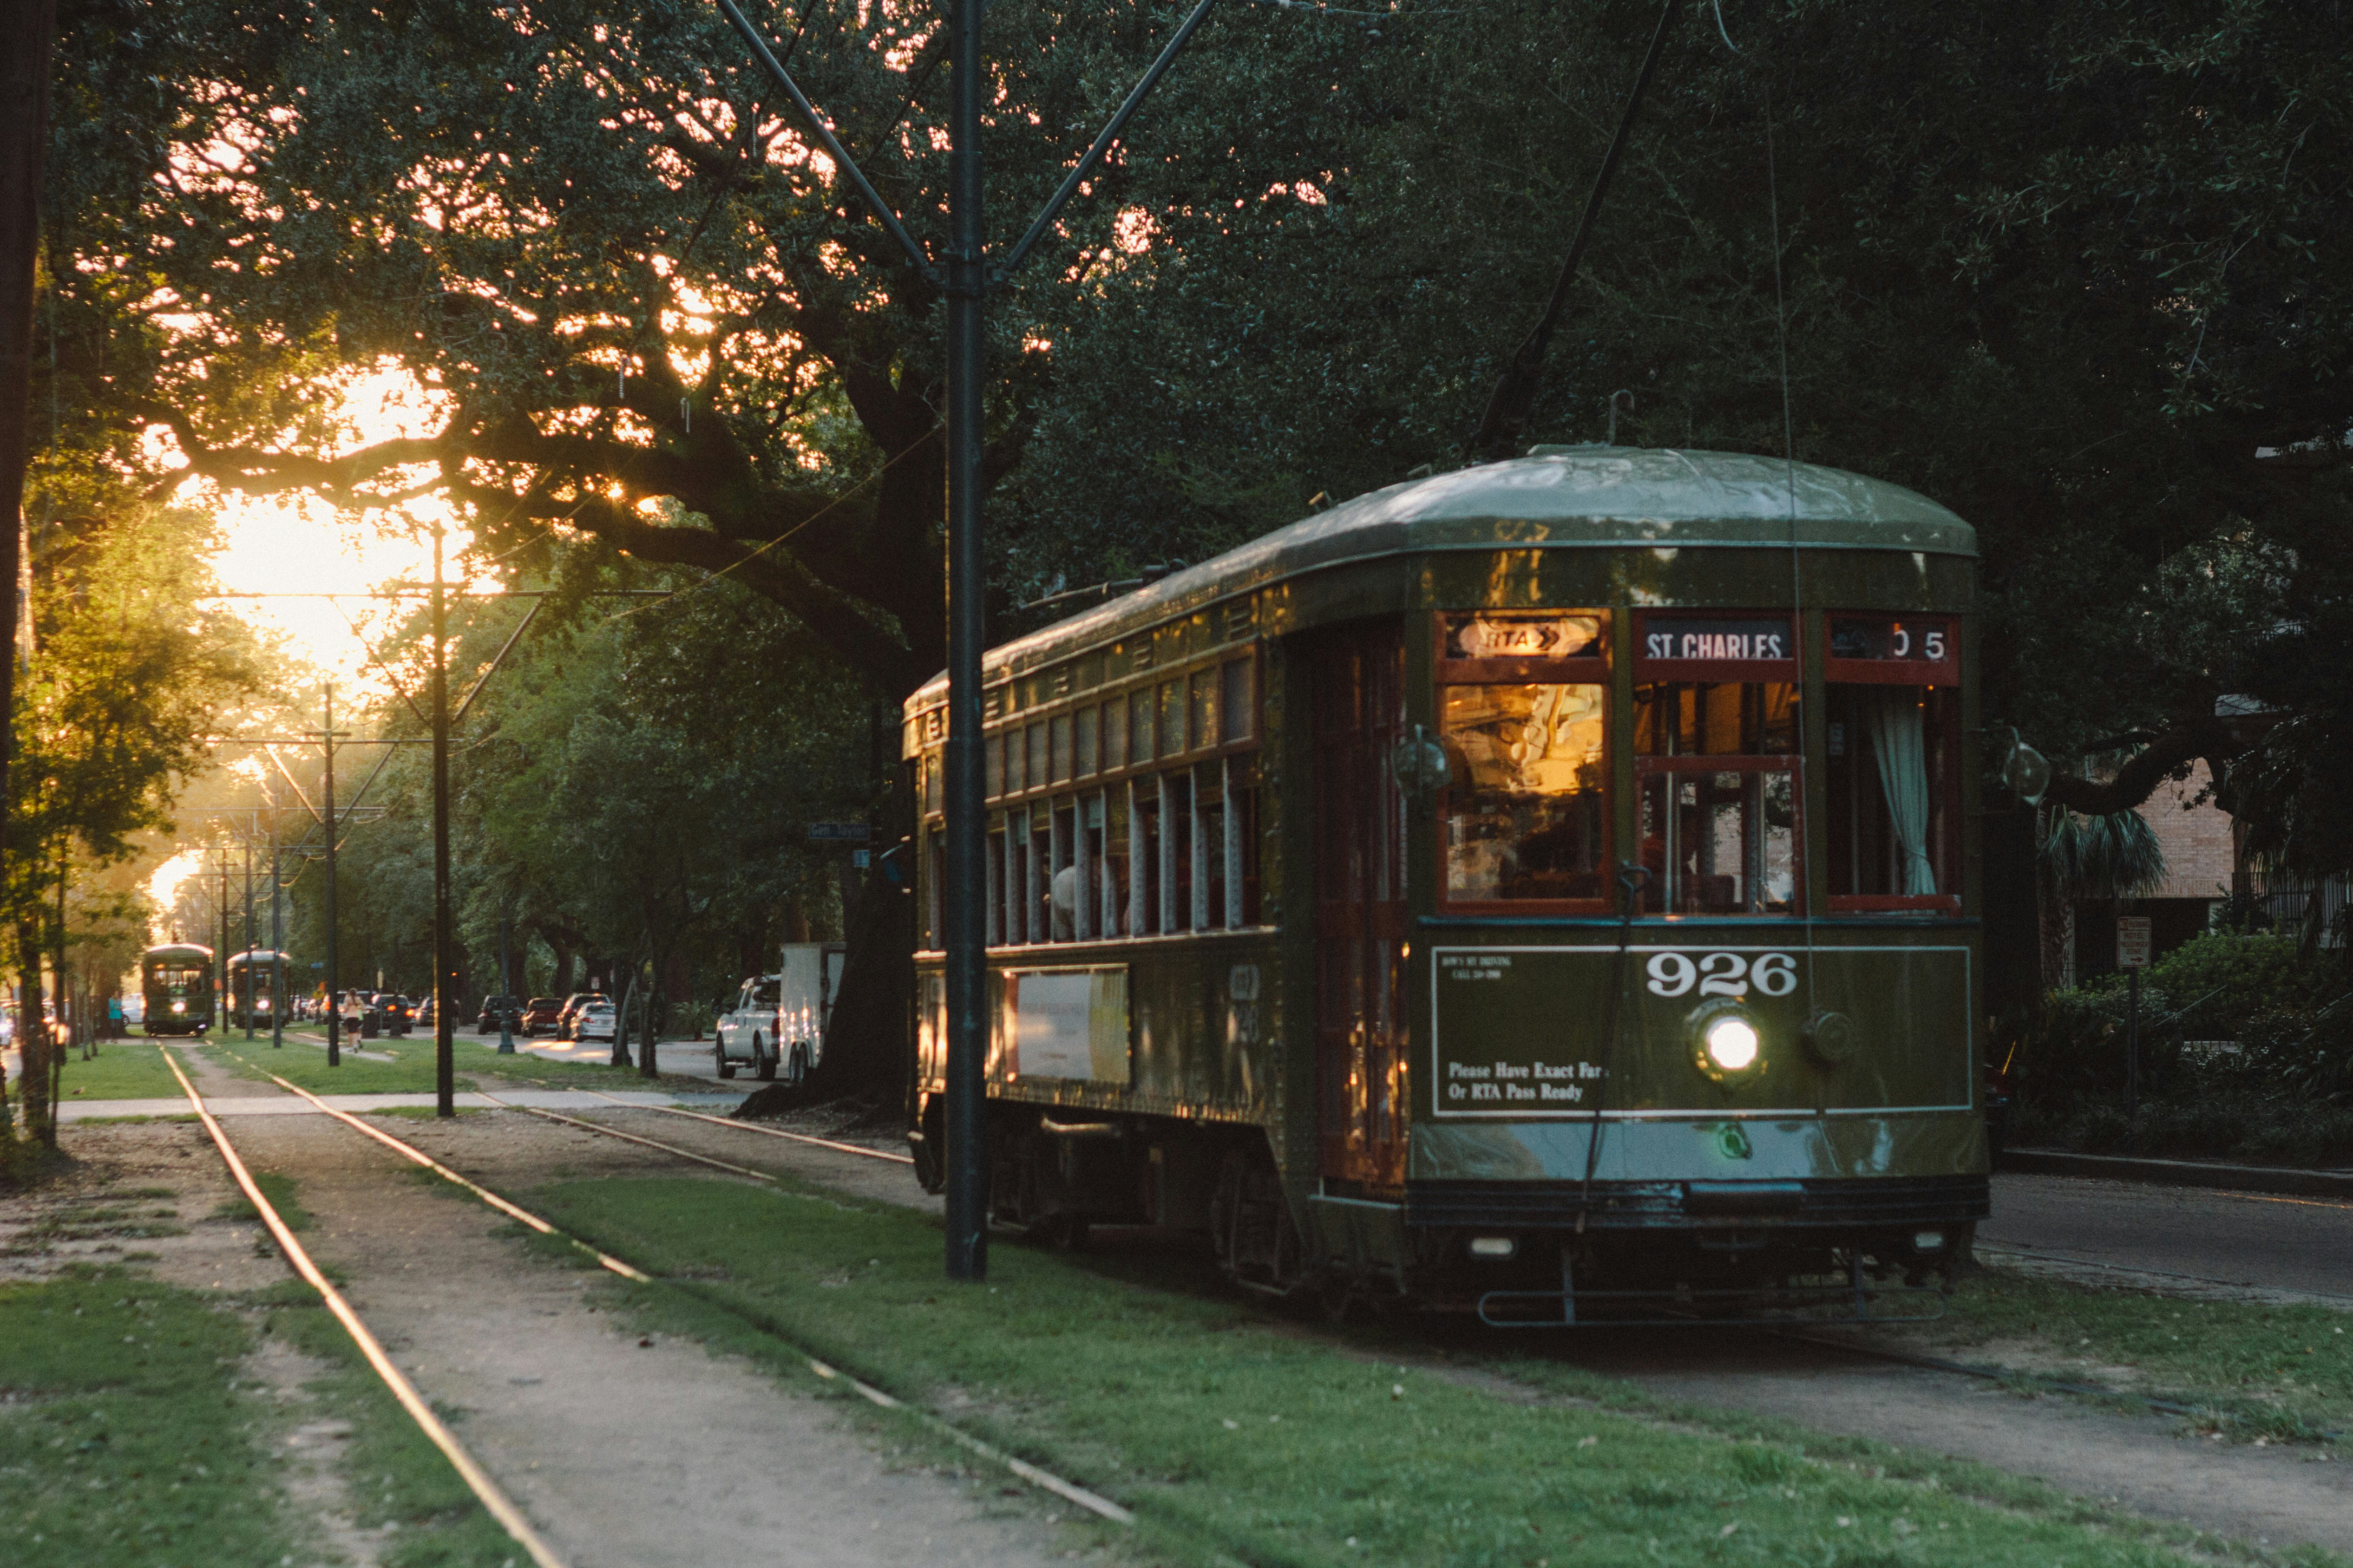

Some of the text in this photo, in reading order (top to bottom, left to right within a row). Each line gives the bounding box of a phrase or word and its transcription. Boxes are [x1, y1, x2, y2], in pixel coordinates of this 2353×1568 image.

[1486, 630, 1528, 647] RTA
[1681, 633, 1782, 658] CHARLES
[1646, 952, 1797, 997] 926
[1449, 1061, 1491, 1078] Please
[1495, 1061, 1530, 1078] Have
[1534, 1061, 1574, 1078] Exact
[1449, 1083, 1583, 1103] Or RTA Pass Ready
